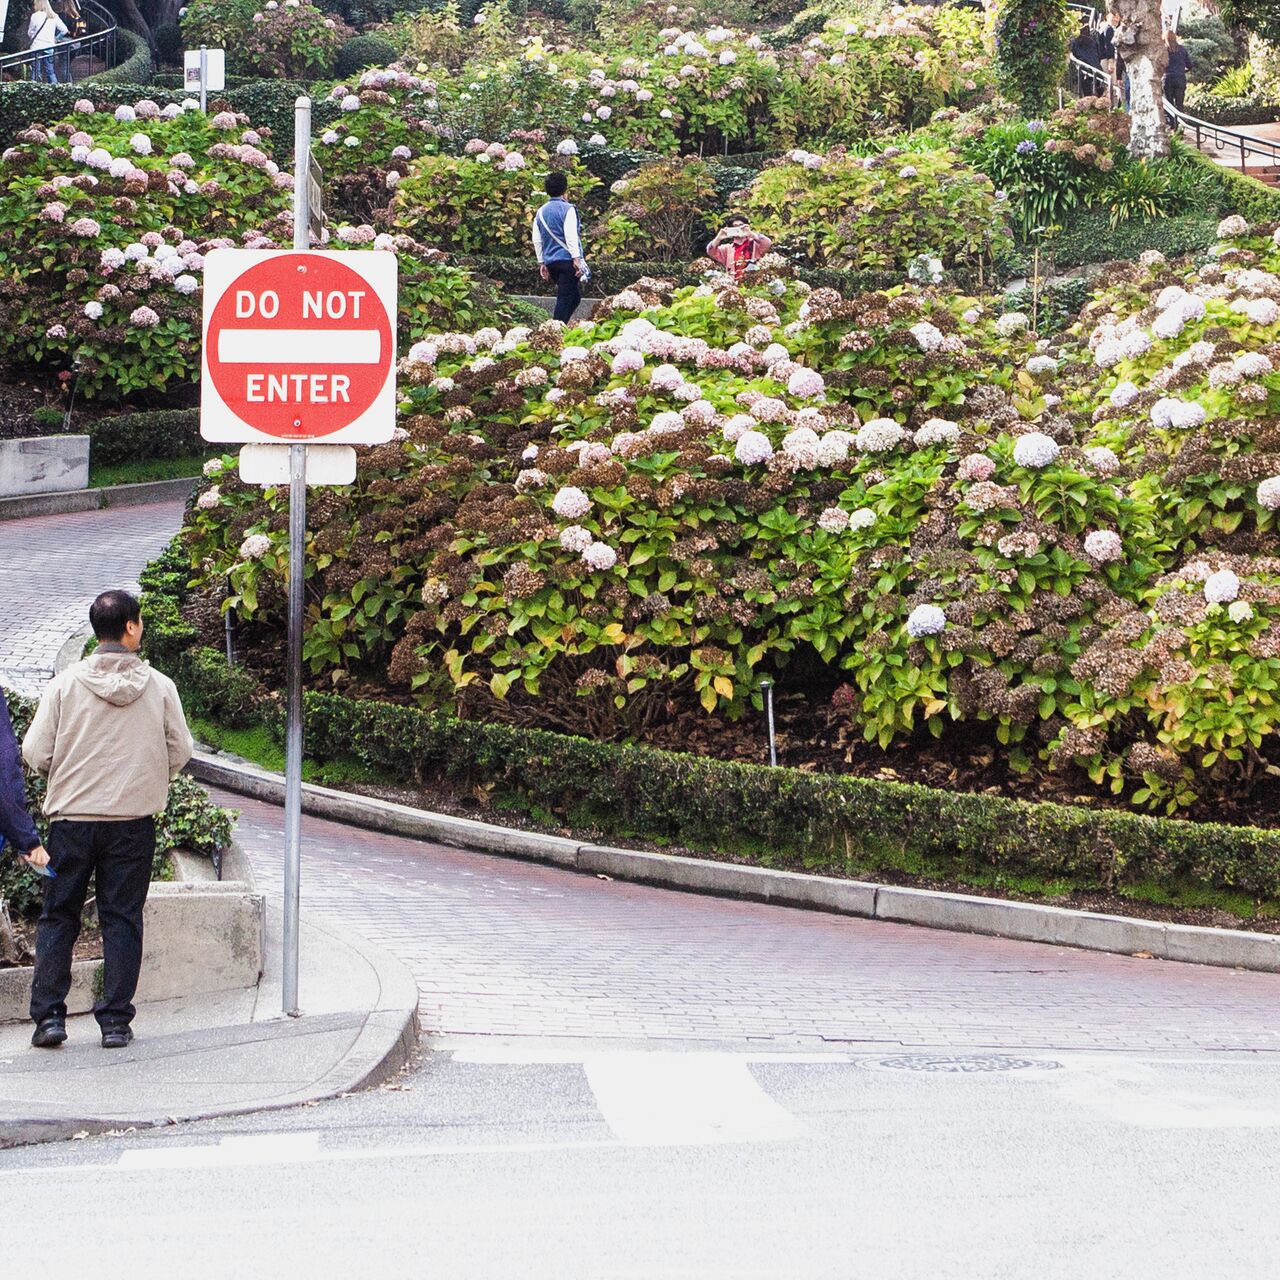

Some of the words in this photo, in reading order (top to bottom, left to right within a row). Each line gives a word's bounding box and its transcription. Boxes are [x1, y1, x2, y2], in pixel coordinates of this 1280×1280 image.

[235, 290, 280, 319] DO
[302, 291, 366, 319] NOT
[246, 374, 351, 402] ENTER
